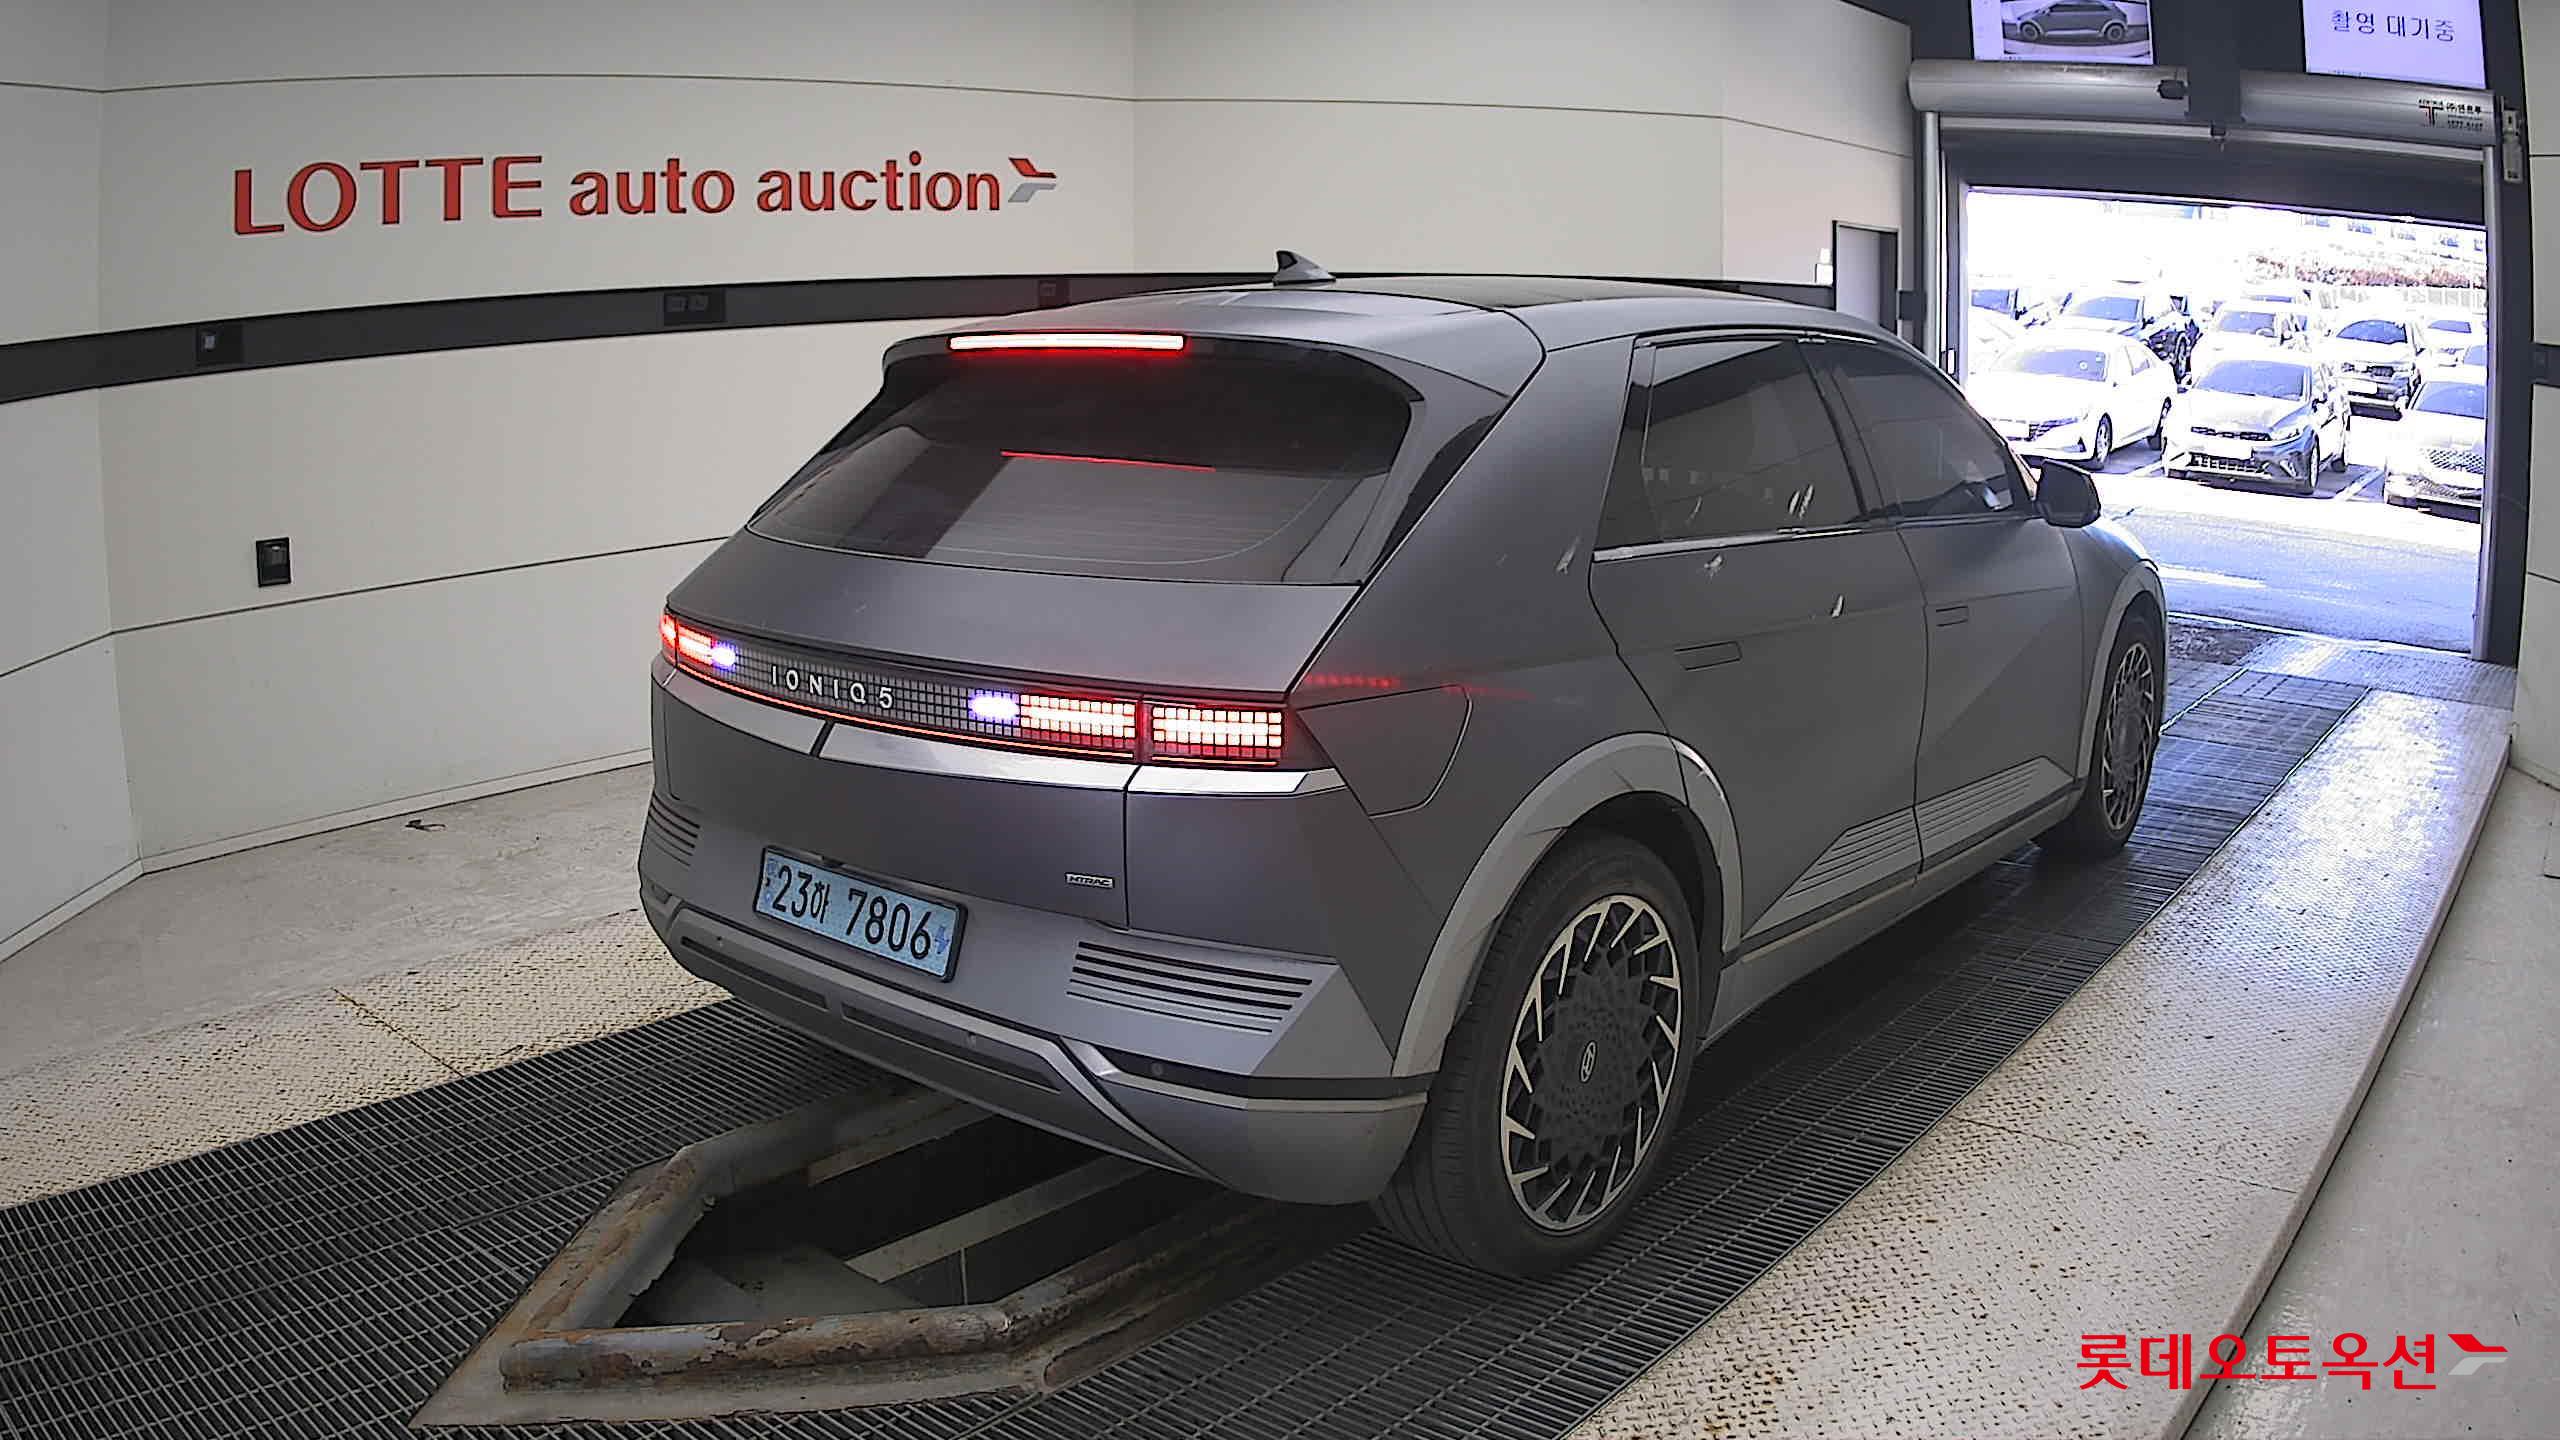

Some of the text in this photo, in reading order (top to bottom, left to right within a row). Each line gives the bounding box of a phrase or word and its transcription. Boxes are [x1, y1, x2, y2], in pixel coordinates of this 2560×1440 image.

[2331, 10, 2455, 42] 촬영 대기중
[234, 150, 1001, 235] LOTTE auto auction
[771, 664, 893, 709] IONIQ 5
[772, 864, 932, 960] 23하 7806
